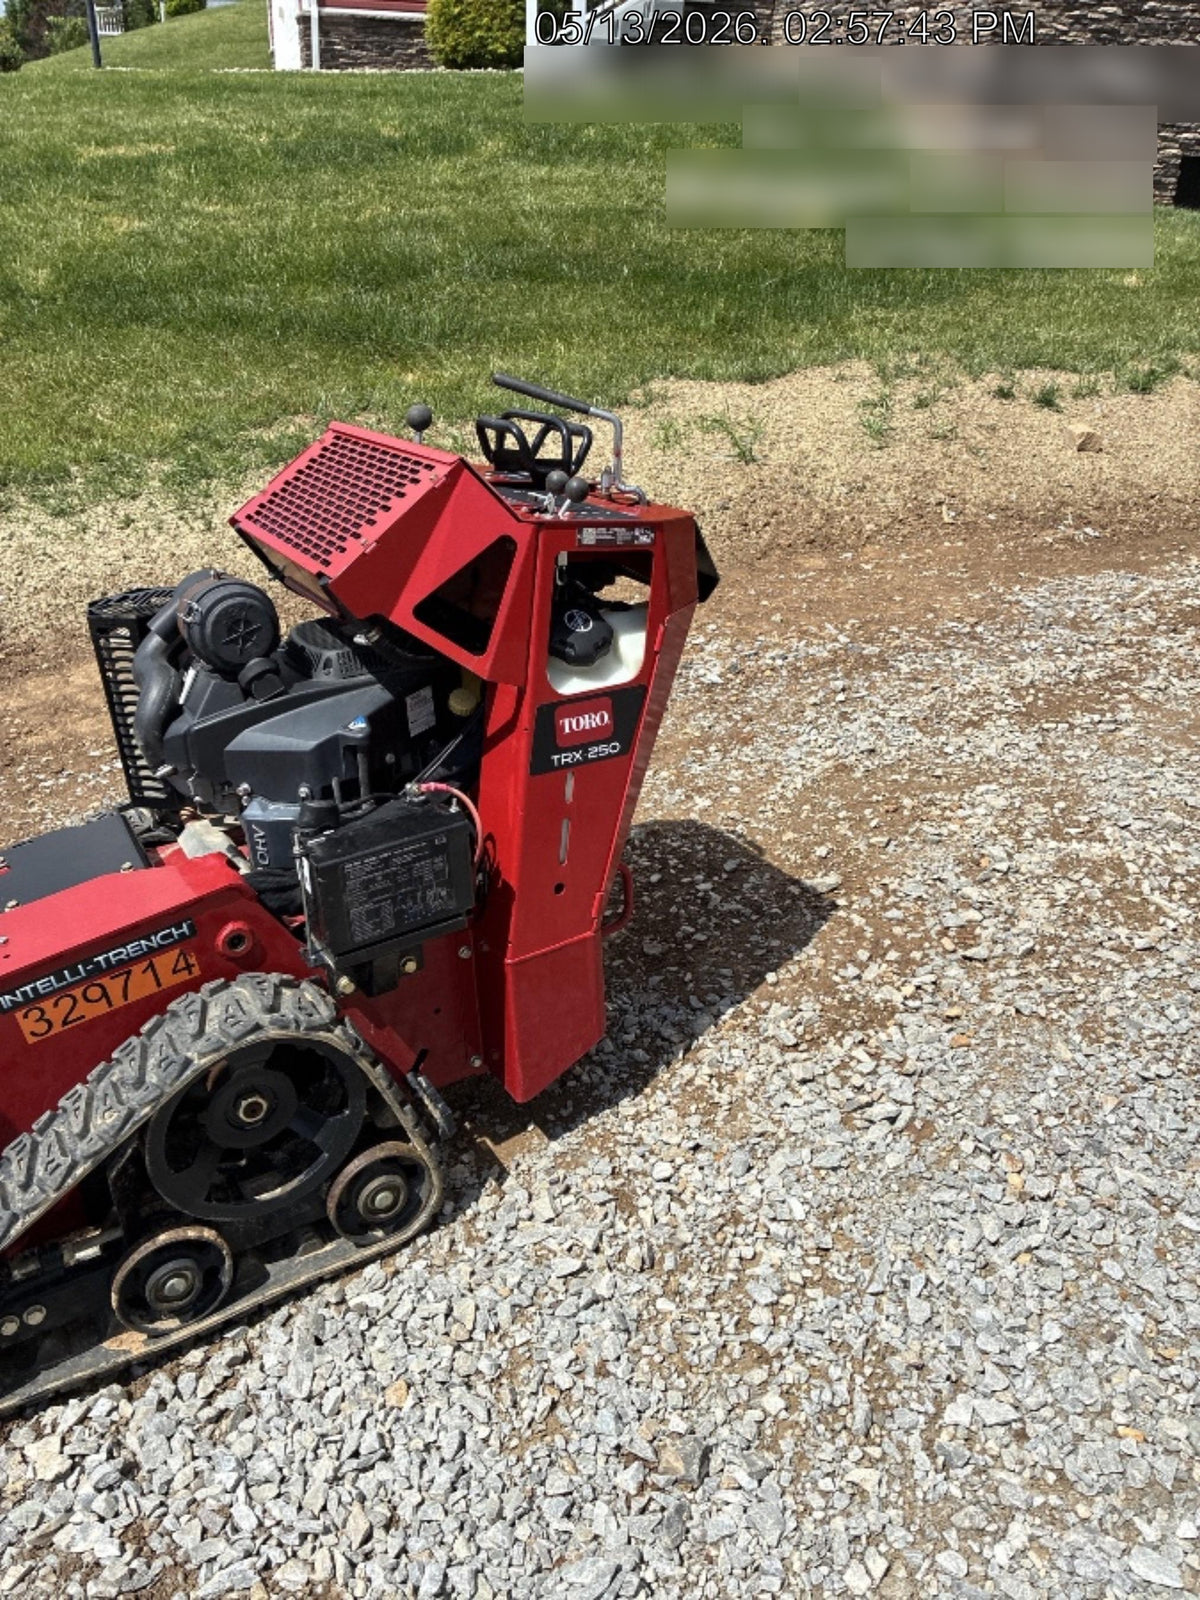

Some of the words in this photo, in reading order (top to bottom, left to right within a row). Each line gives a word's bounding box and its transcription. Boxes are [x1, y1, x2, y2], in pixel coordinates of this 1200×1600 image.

[559, 710, 609, 735] TORO
[251, 824, 269, 865] OHV
[0, 922, 190, 1009] INTELLI-TRENCH
[22, 949, 197, 1038] 329714
